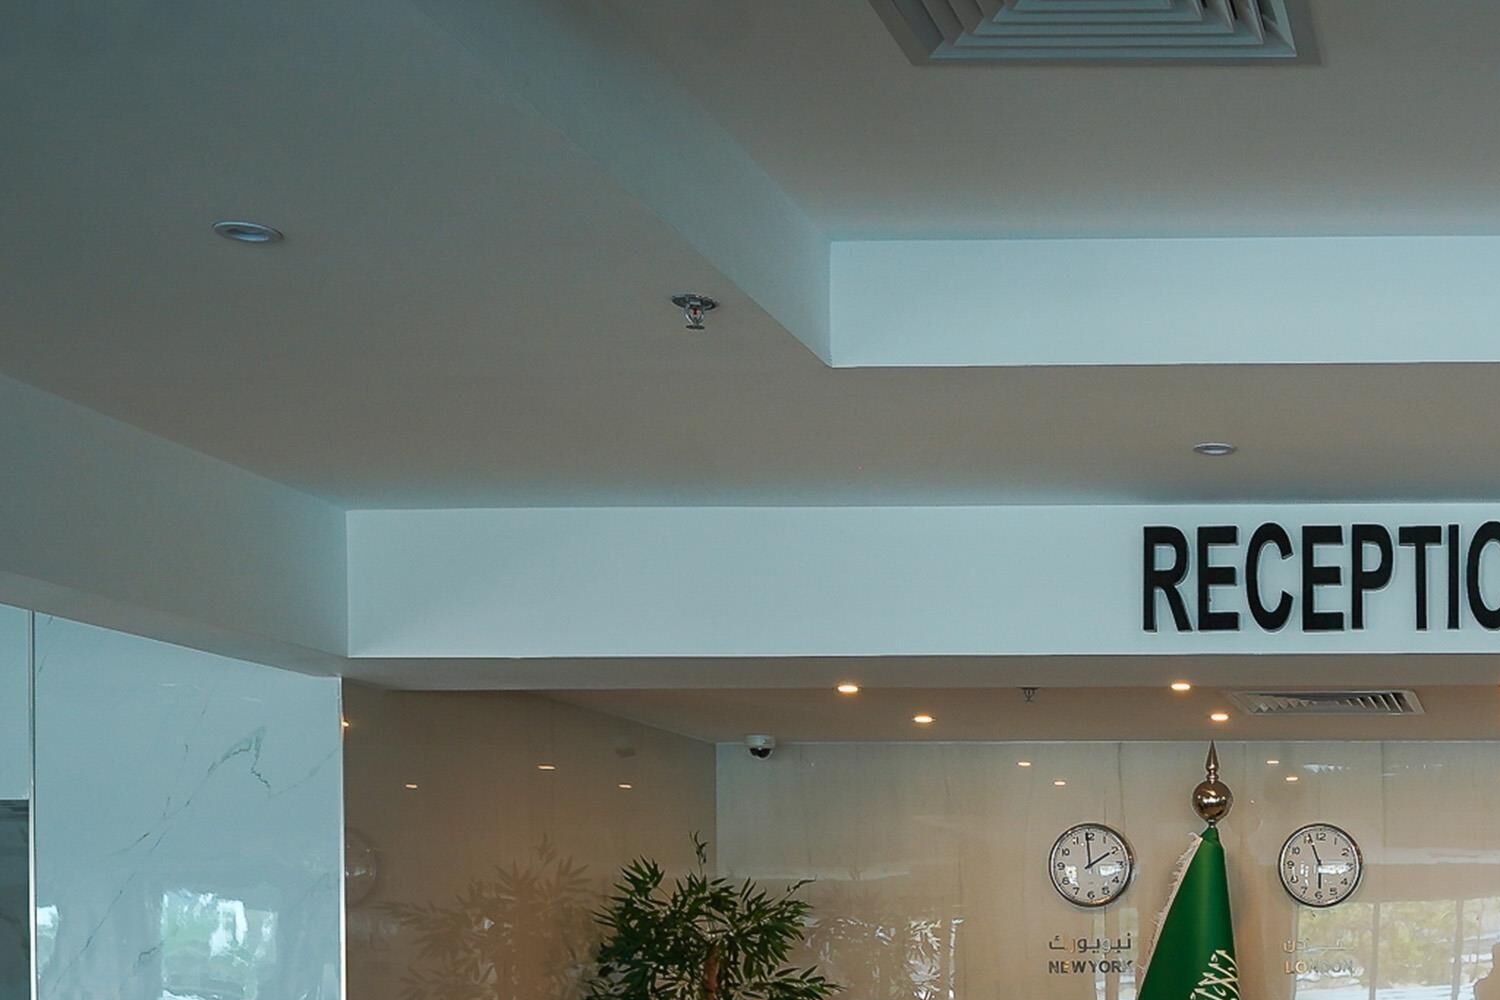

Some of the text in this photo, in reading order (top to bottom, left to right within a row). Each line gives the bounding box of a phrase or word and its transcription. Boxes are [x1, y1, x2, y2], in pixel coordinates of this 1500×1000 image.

[1316, 833, 1326, 841] 12
[1342, 848, 1350, 856] 2
[1057, 862, 1065, 870] 9
[1073, 887, 1080, 895] 7
[1087, 891, 1095, 899] 6
[1301, 887, 1307, 895] 7
[1315, 891, 1323, 900] 6
[1048, 932, 1132, 953] نيويورك
[1048, 961, 1132, 974] NEW YORK
